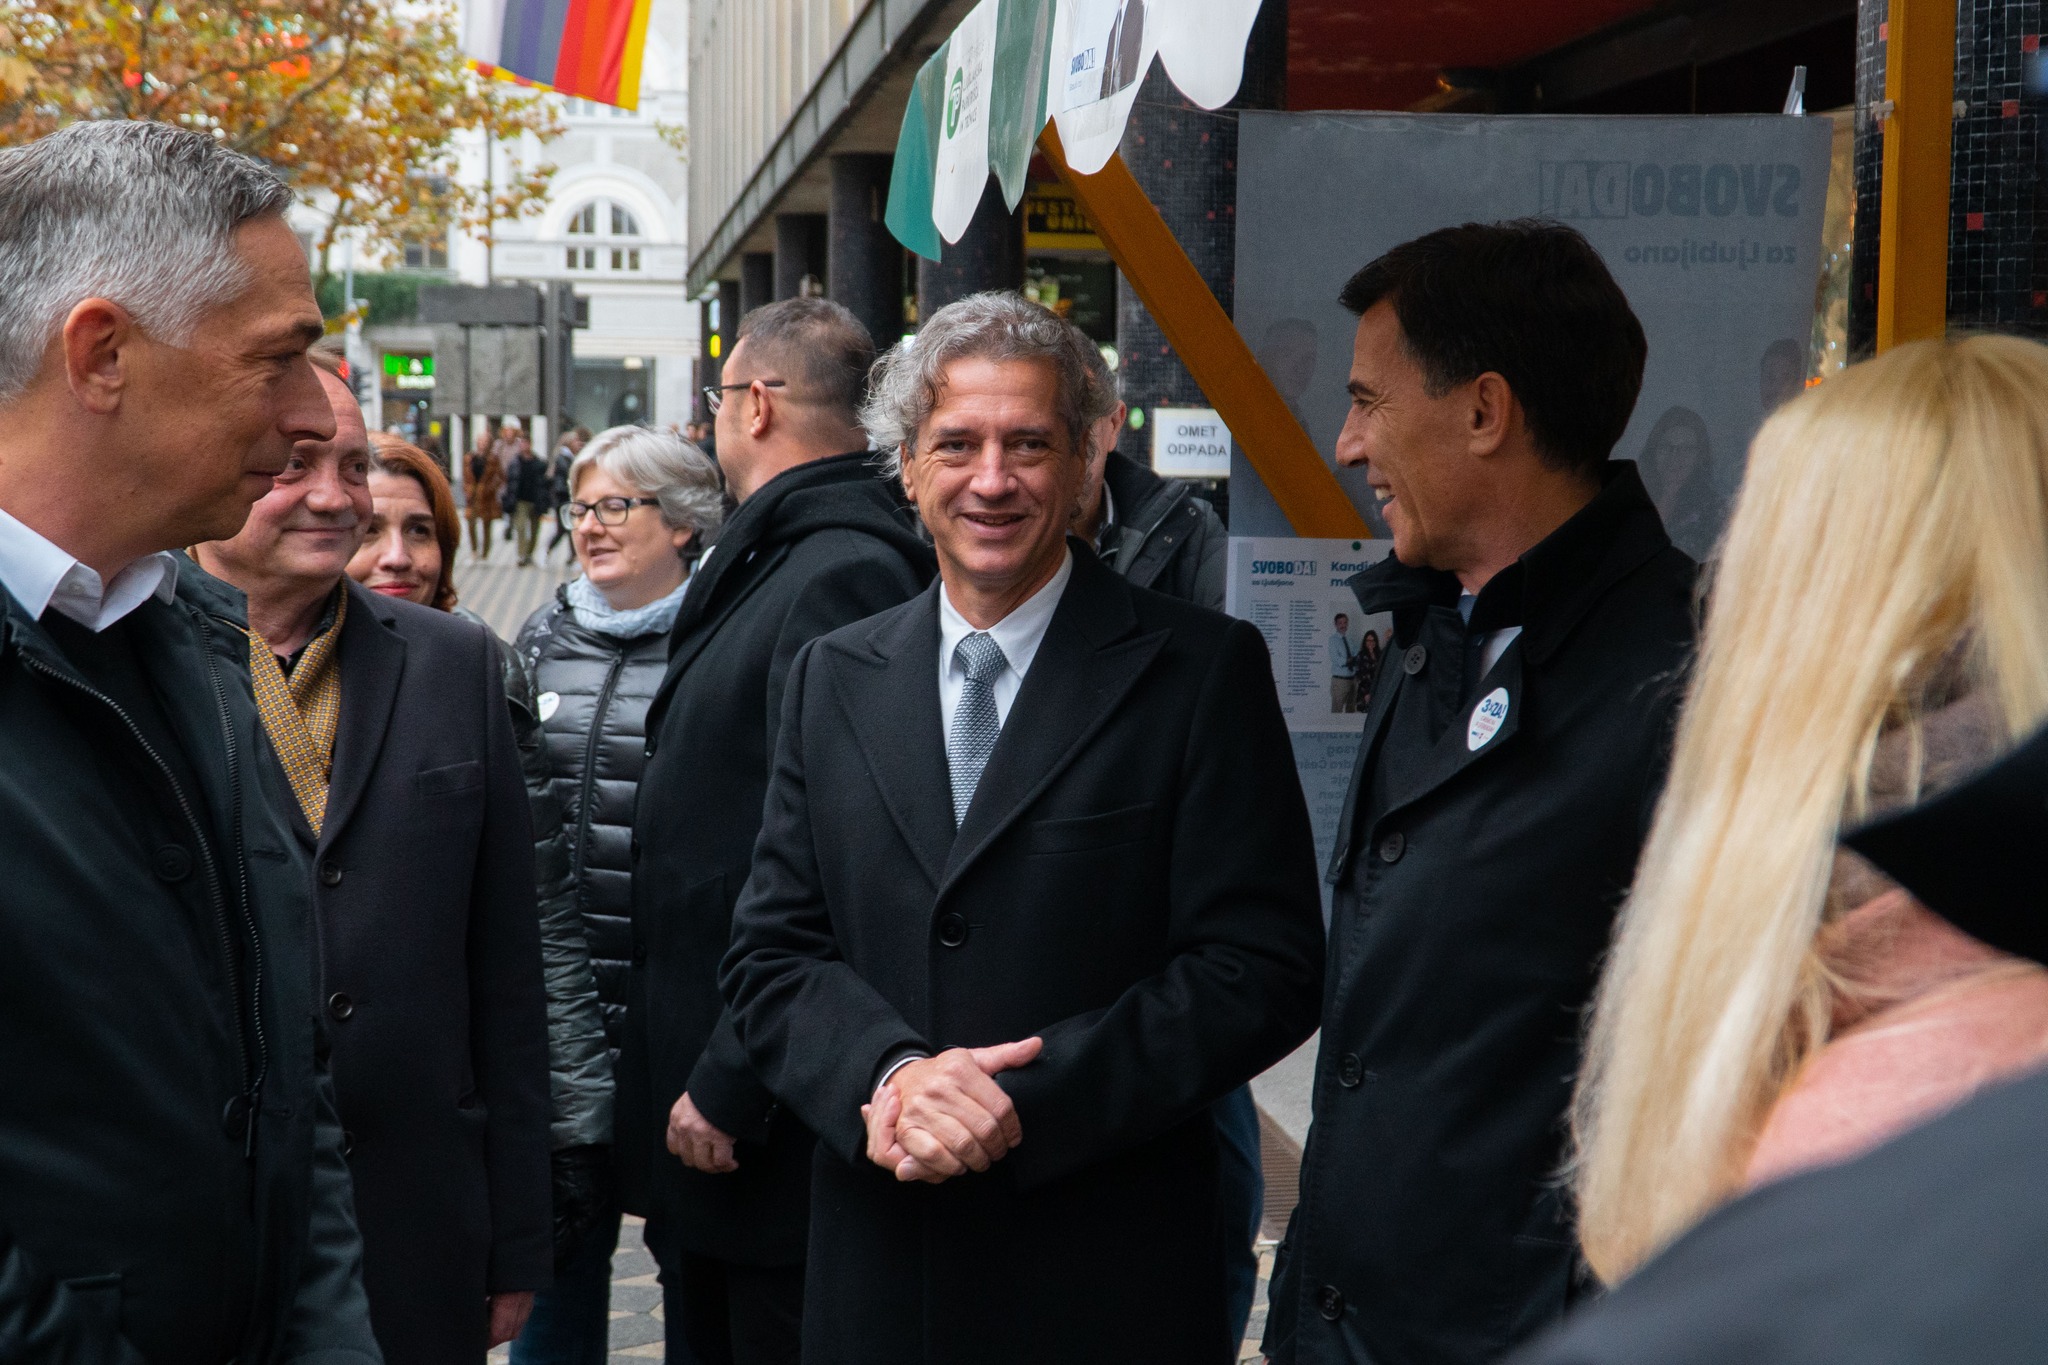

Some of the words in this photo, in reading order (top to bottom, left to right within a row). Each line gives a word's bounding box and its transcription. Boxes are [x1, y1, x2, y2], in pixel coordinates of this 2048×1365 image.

[1178, 425, 1217, 437] OMET
[1167, 443, 1227, 456] ODPADA
[1252, 560, 1318, 575] SVOBODA!
[1331, 561, 1377, 573] Kandi
